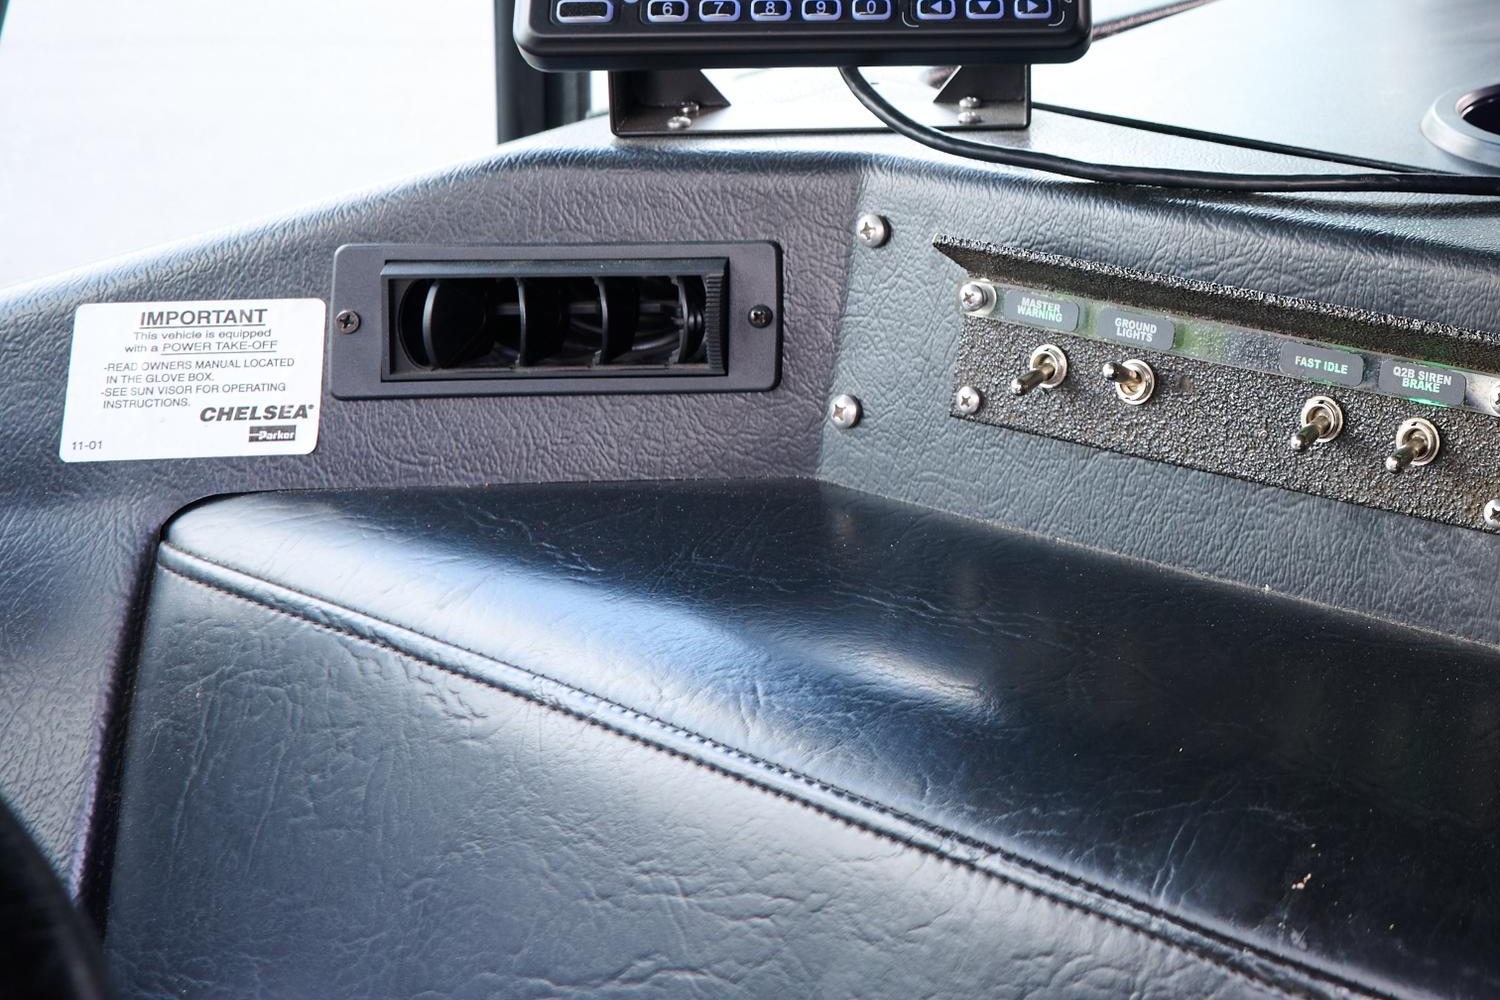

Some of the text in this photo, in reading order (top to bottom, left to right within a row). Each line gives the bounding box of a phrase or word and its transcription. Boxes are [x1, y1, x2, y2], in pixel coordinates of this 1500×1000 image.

[662, 1, 877, 16] 6 7 8 9 0
[1021, 297, 1061, 313] MASTER
[140, 309, 268, 326] IMPORTANT
[1017, 305, 1063, 323] WARNING
[1115, 317, 1157, 334] GROUND
[133, 329, 272, 340] This vehicle is equipped
[1117, 328, 1153, 342] LIGHTS
[125, 344, 147, 353] with
[163, 342, 212, 352] POWER
[216, 340, 278, 350] TAKE-OFF
[141, 361, 192, 371] OWNERS
[195, 360, 241, 370] MANUAL
[244, 358, 295, 368] LOCATED
[1295, 356, 1348, 375] FAST IDLE
[106, 372, 214, 384] IN THE GLOVE BOX.
[1393, 366, 1452, 386] Q2B SIREN
[130, 386, 154, 396] SUN
[158, 385, 192, 395] VISOR
[196, 384, 219, 394] FOR
[222, 382, 286, 393] OPERATING
[1402, 378, 1440, 393] BRAKE
[103, 397, 191, 409] INSTRUCTIONS.
[258, 430, 295, 441] Parker
[71, 441, 103, 450] 11-01
